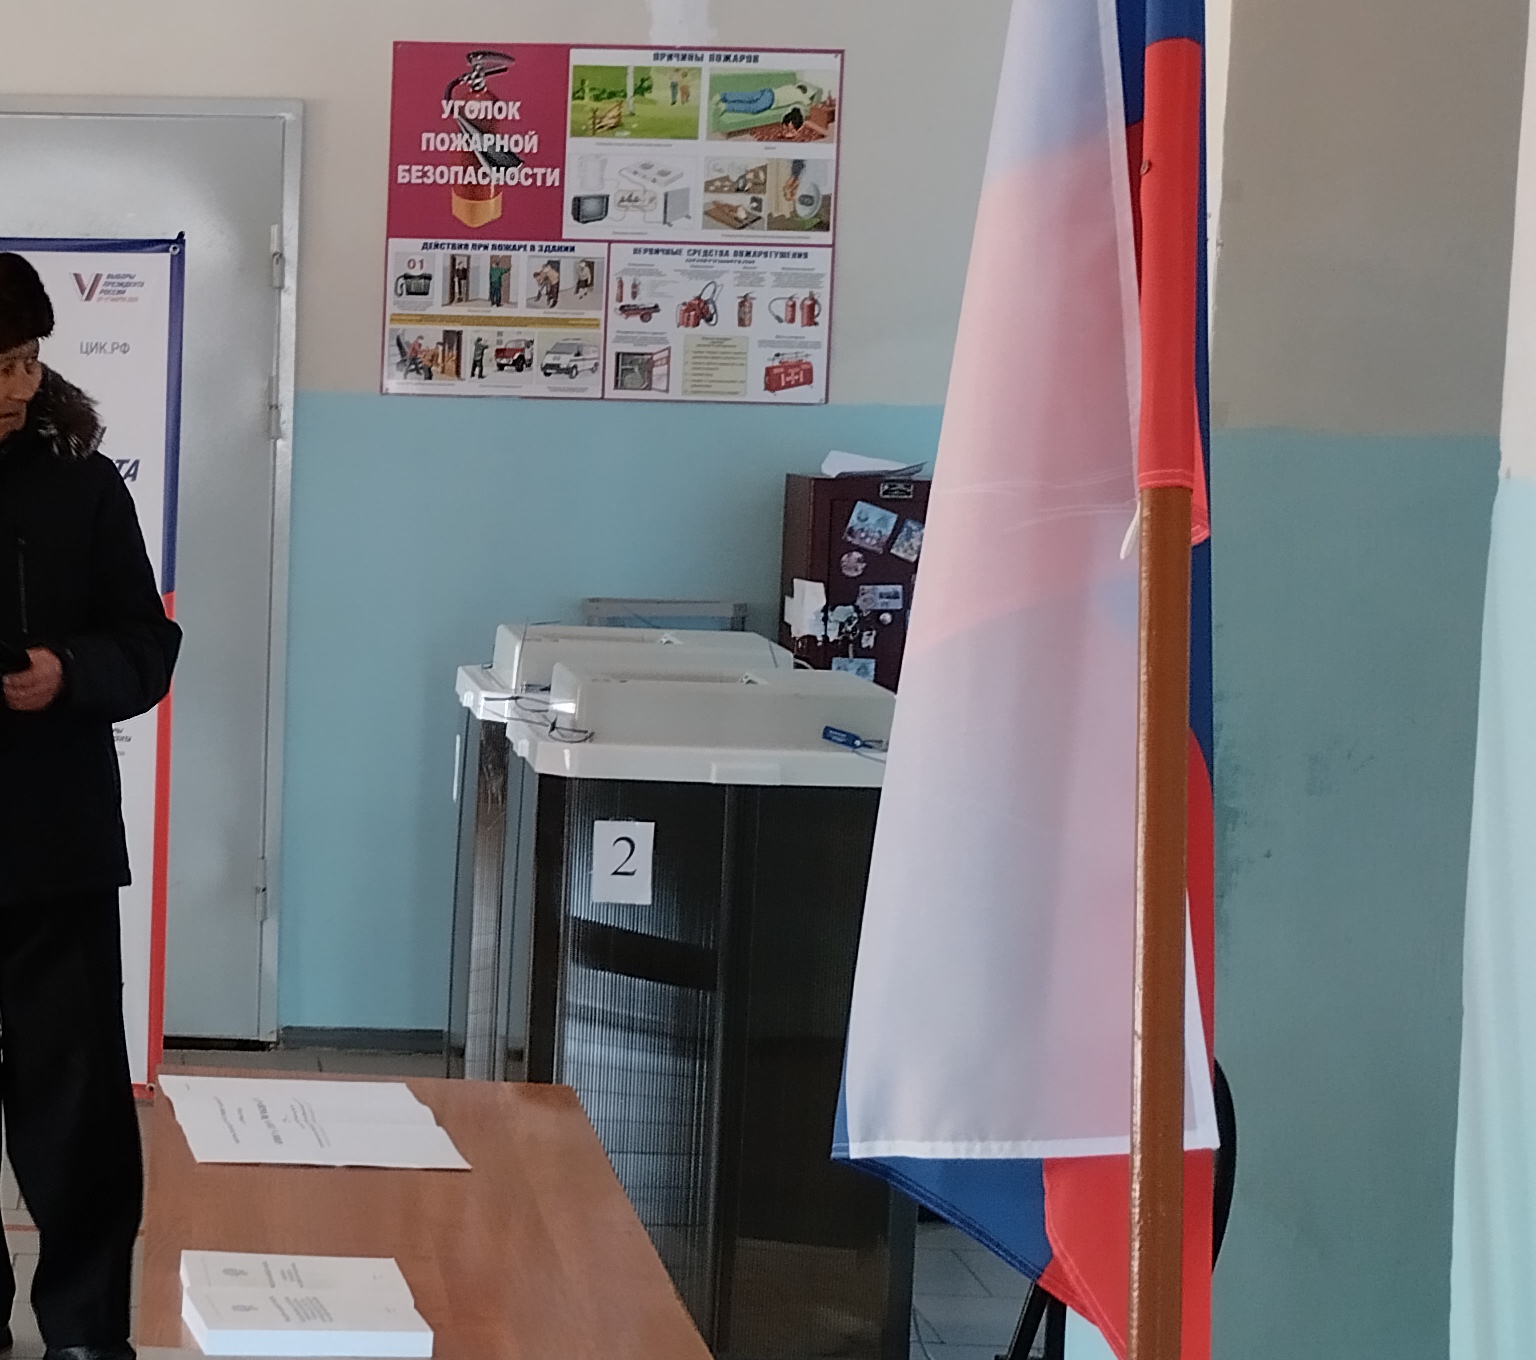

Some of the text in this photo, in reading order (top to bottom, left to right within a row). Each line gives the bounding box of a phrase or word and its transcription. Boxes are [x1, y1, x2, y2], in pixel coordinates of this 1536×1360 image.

[653, 52, 704, 62] ПРИЧИНЫ
[441, 99, 521, 120] УГОЛОК
[420, 130, 540, 153] ПОЖАРНОЙ
[396, 164, 561, 187] БЕЗОПАСНОСТИ
[421, 242, 469, 251] ДЕЙСТВИЯ
[471, 243, 489, 251] ПРИ
[491, 243, 528, 252] ПОЖАРЕ
[537, 244, 576, 253] ЗДАНИИ
[407, 259, 424, 270] 01
[79, 341, 131, 357] ЦИК.РФ
[610, 836, 638, 876] 2
